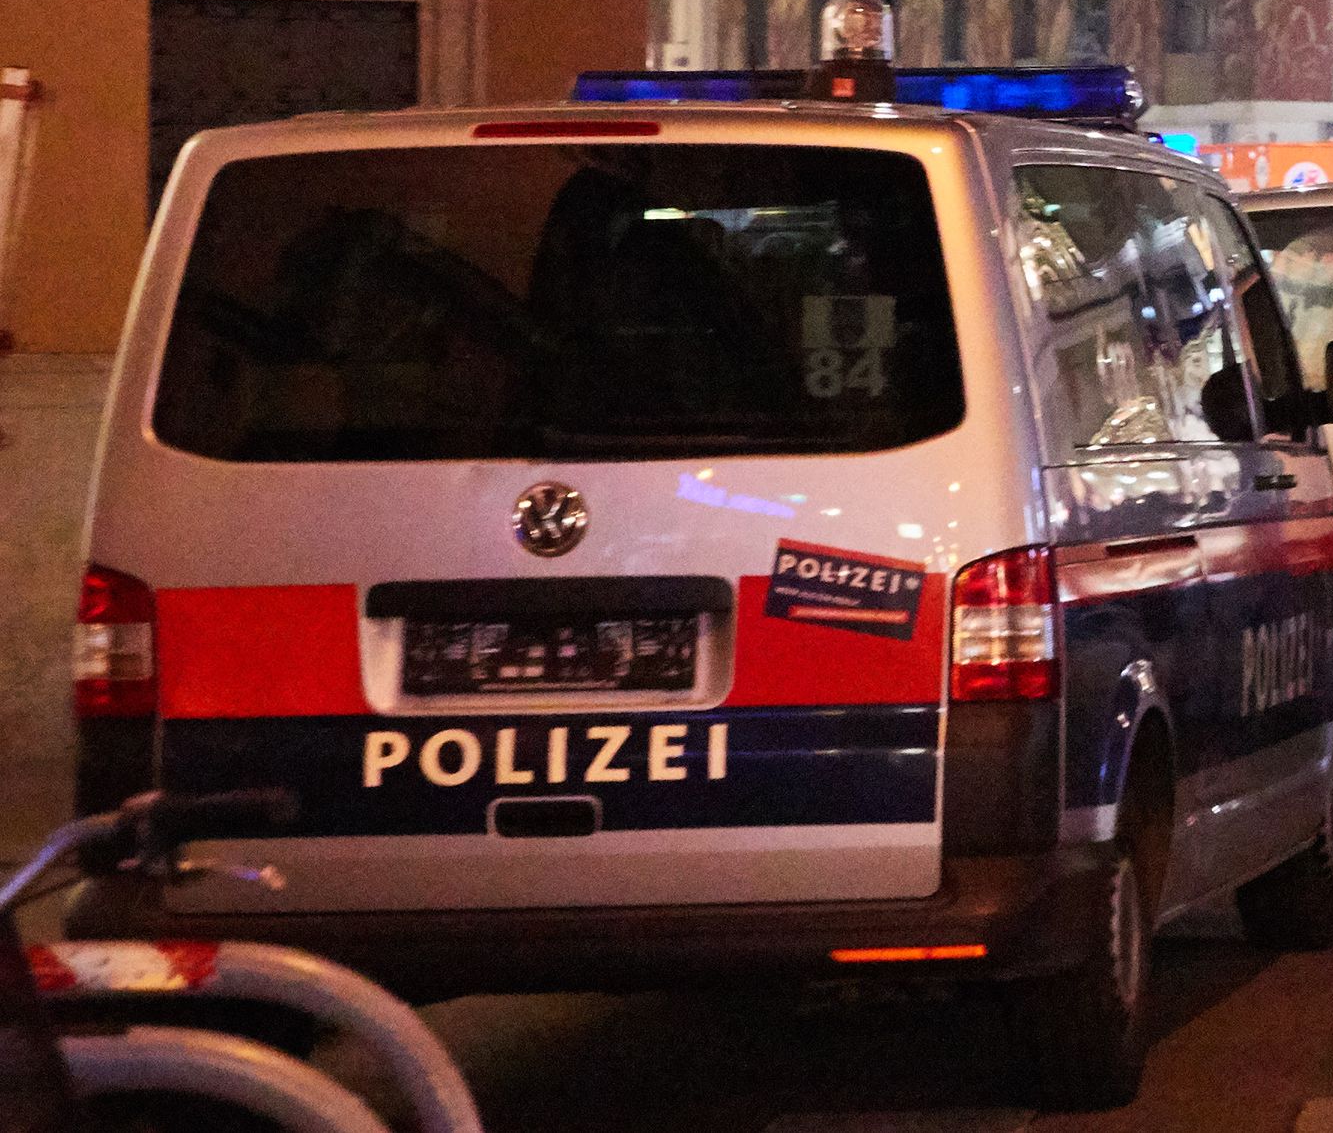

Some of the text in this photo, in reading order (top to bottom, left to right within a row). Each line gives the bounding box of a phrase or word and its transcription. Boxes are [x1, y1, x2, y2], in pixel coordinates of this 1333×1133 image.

[806, 350, 887, 398] 84
[778, 553, 901, 595] POLIZEI
[1240, 611, 1314, 717] POLIZEI
[363, 724, 727, 789] POLIZEI
